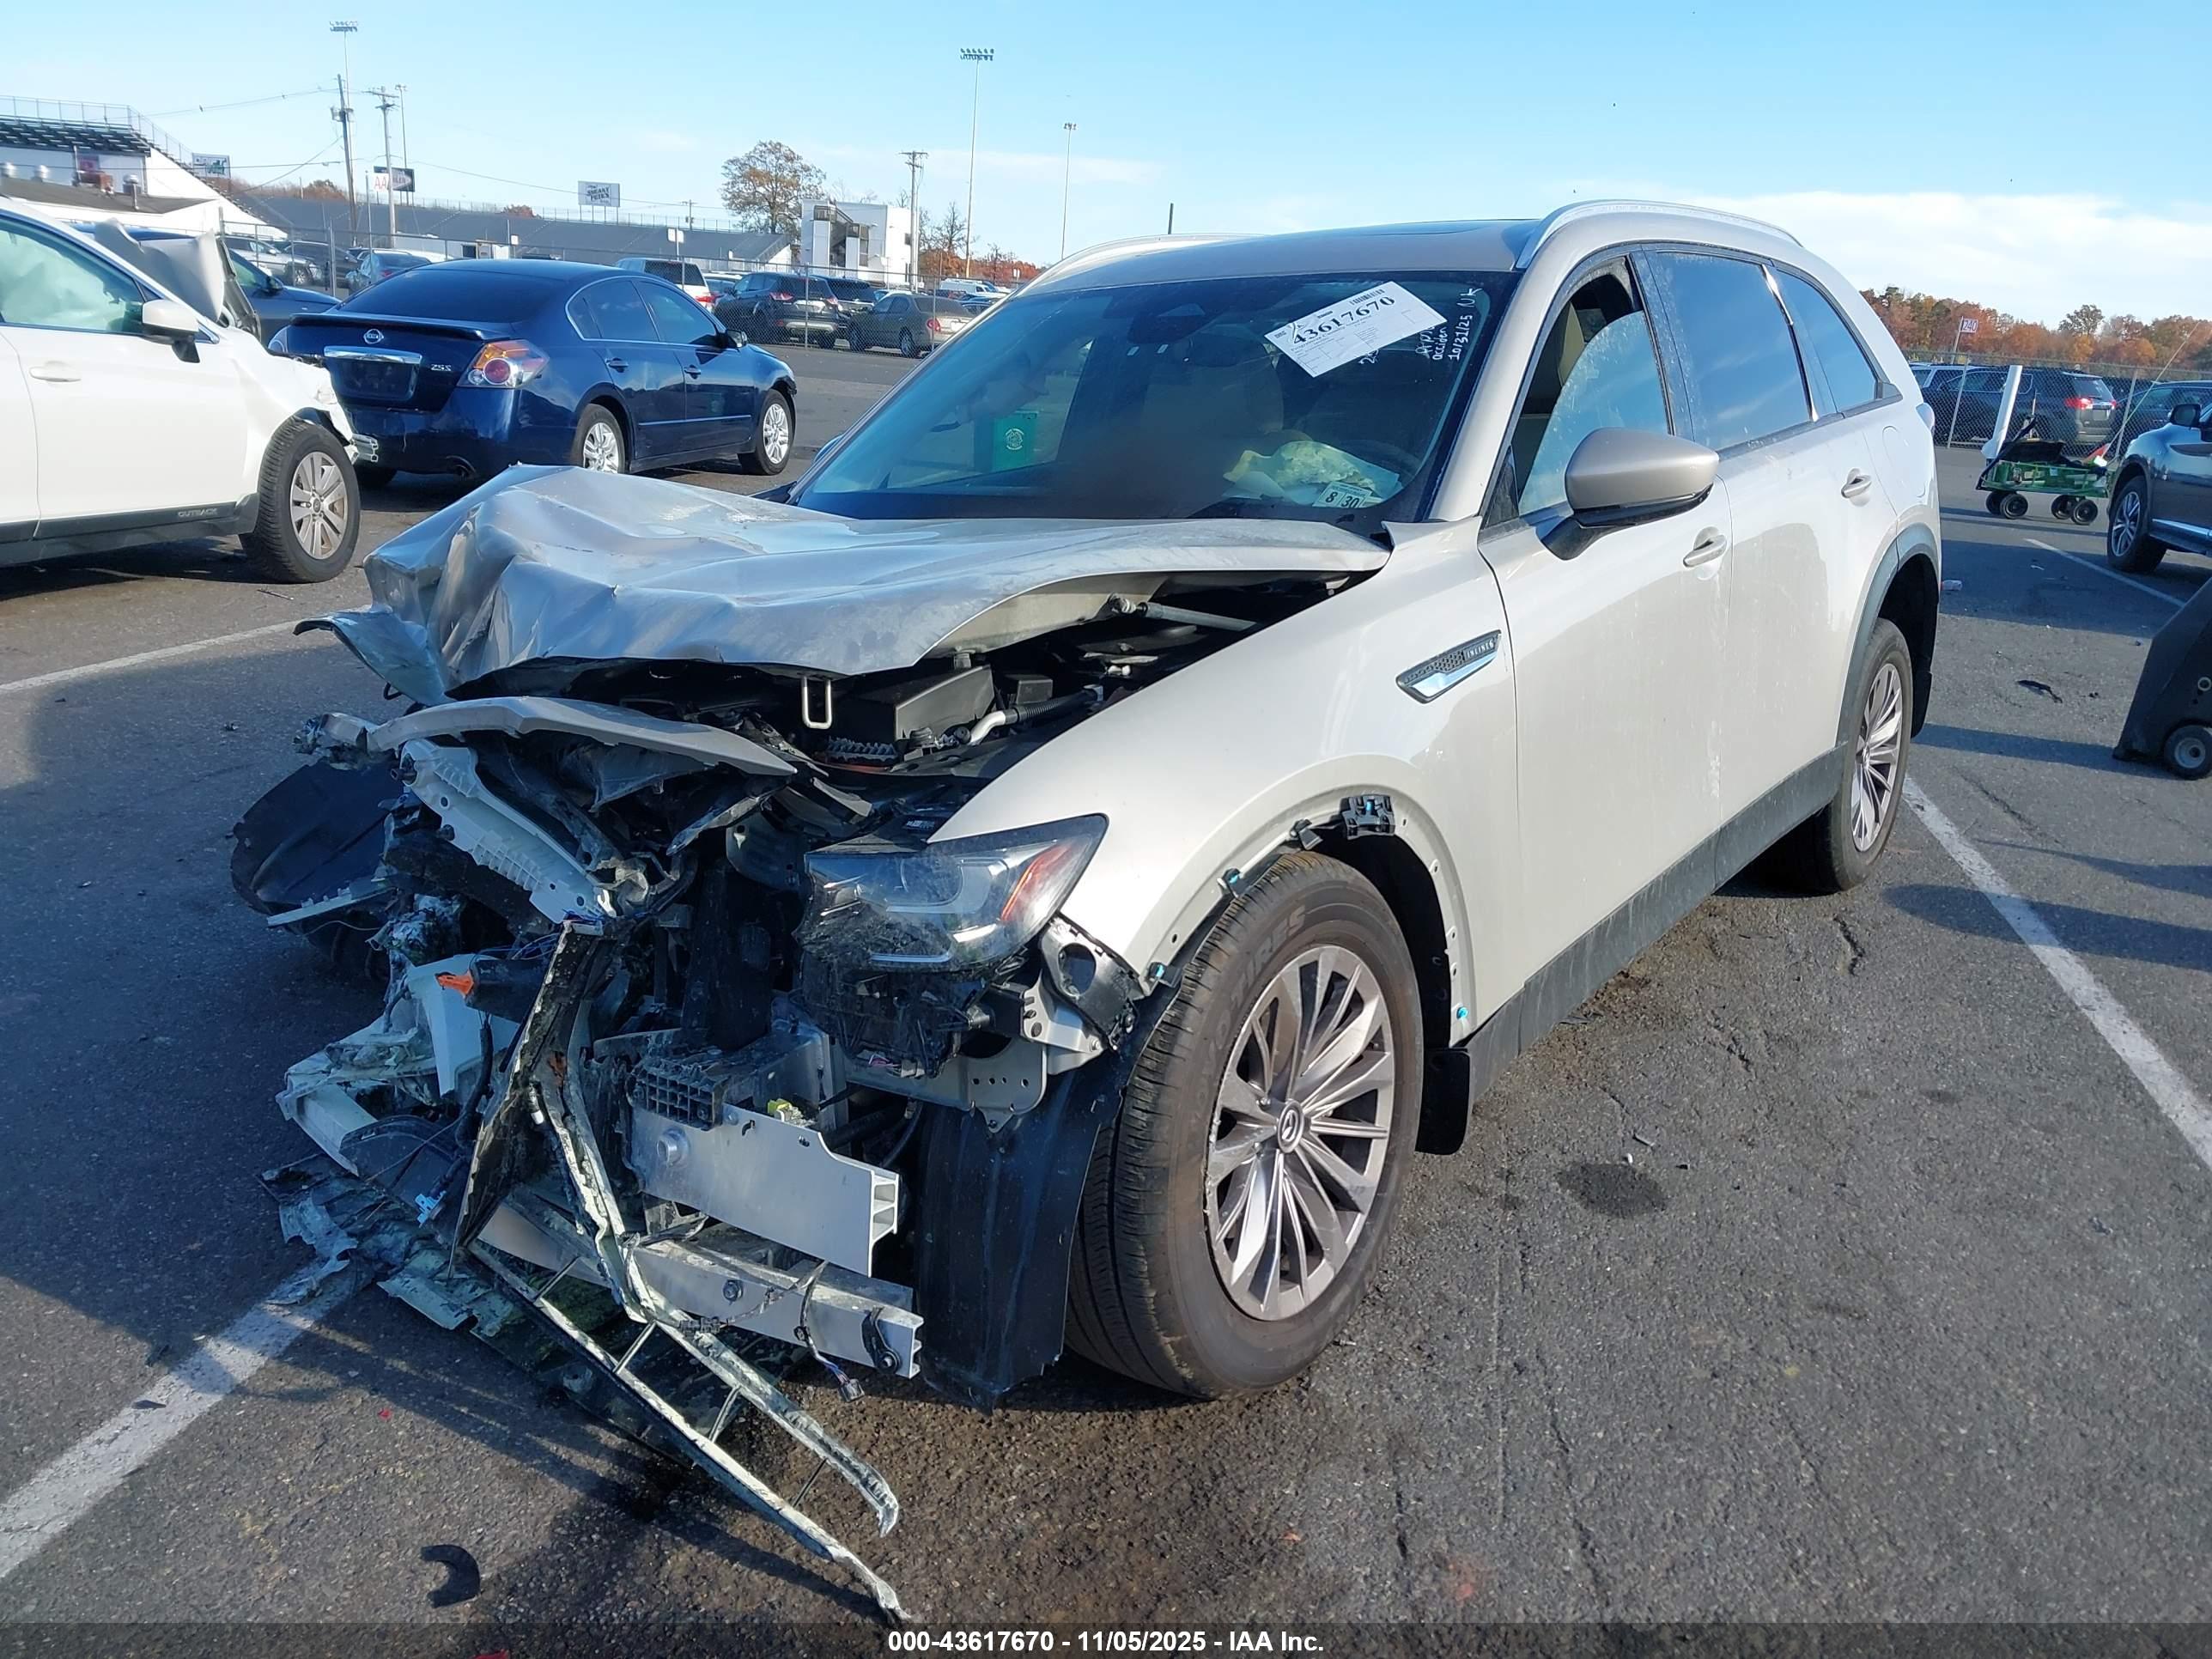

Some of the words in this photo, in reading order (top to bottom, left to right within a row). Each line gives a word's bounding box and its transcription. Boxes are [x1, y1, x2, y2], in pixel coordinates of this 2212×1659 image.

[1294, 296, 1395, 343] 43617670
[1325, 491, 1339, 503] 8
[1340, 495, 1360, 509] 30
